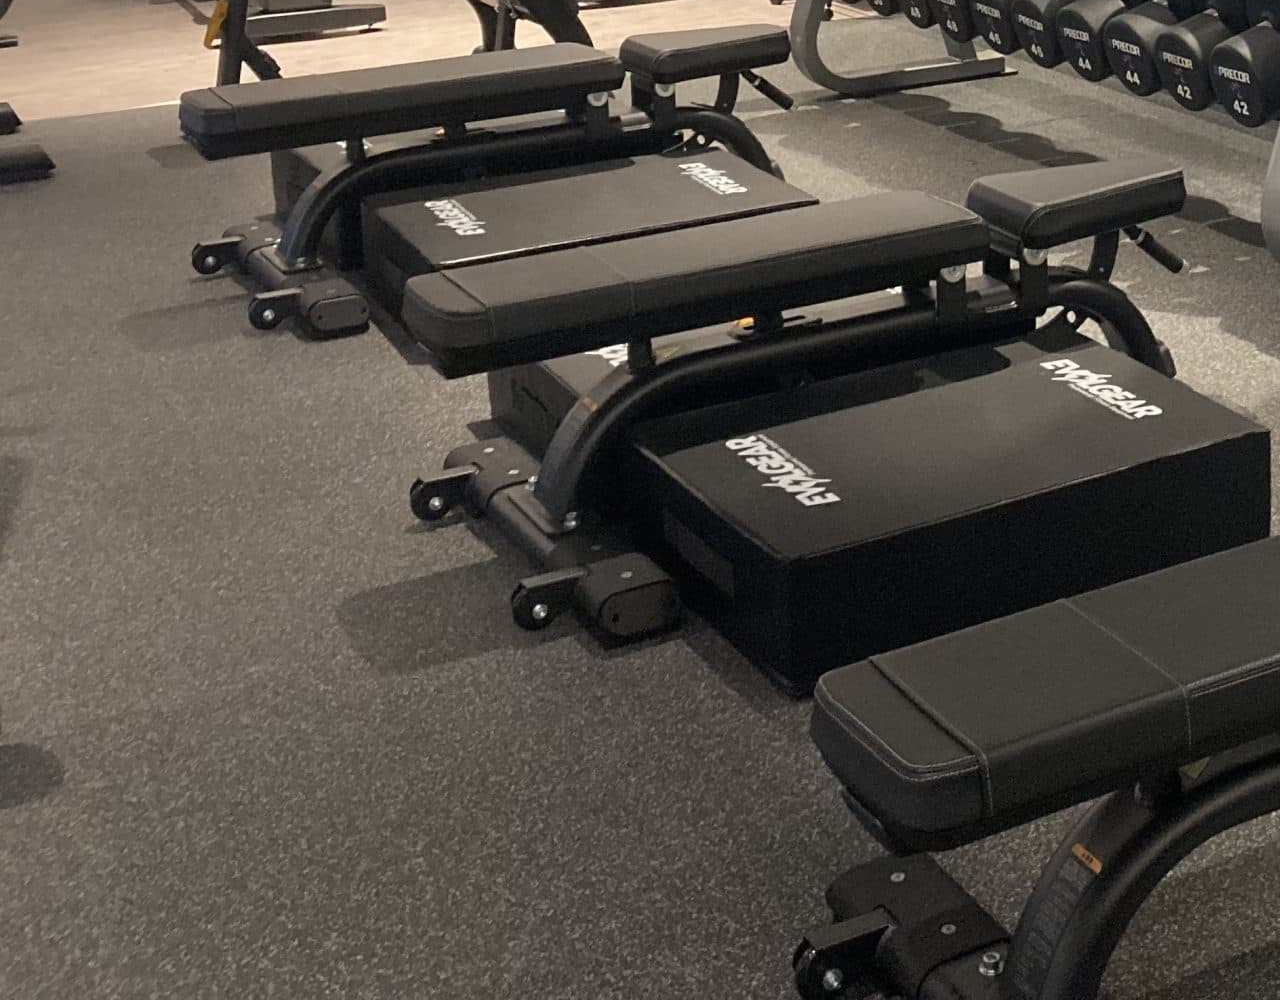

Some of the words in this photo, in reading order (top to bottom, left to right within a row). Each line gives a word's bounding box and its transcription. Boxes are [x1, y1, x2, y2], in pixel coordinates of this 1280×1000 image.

[1112, 39, 1141, 56] PRECOR
[1078, 57, 1092, 71] 44
[1162, 52, 1193, 70] PRECOR
[1126, 70, 1141, 85] 44
[1218, 66, 1250, 84] PRECOR
[1177, 84, 1192, 100] 42
[1233, 100, 1250, 115] 42
